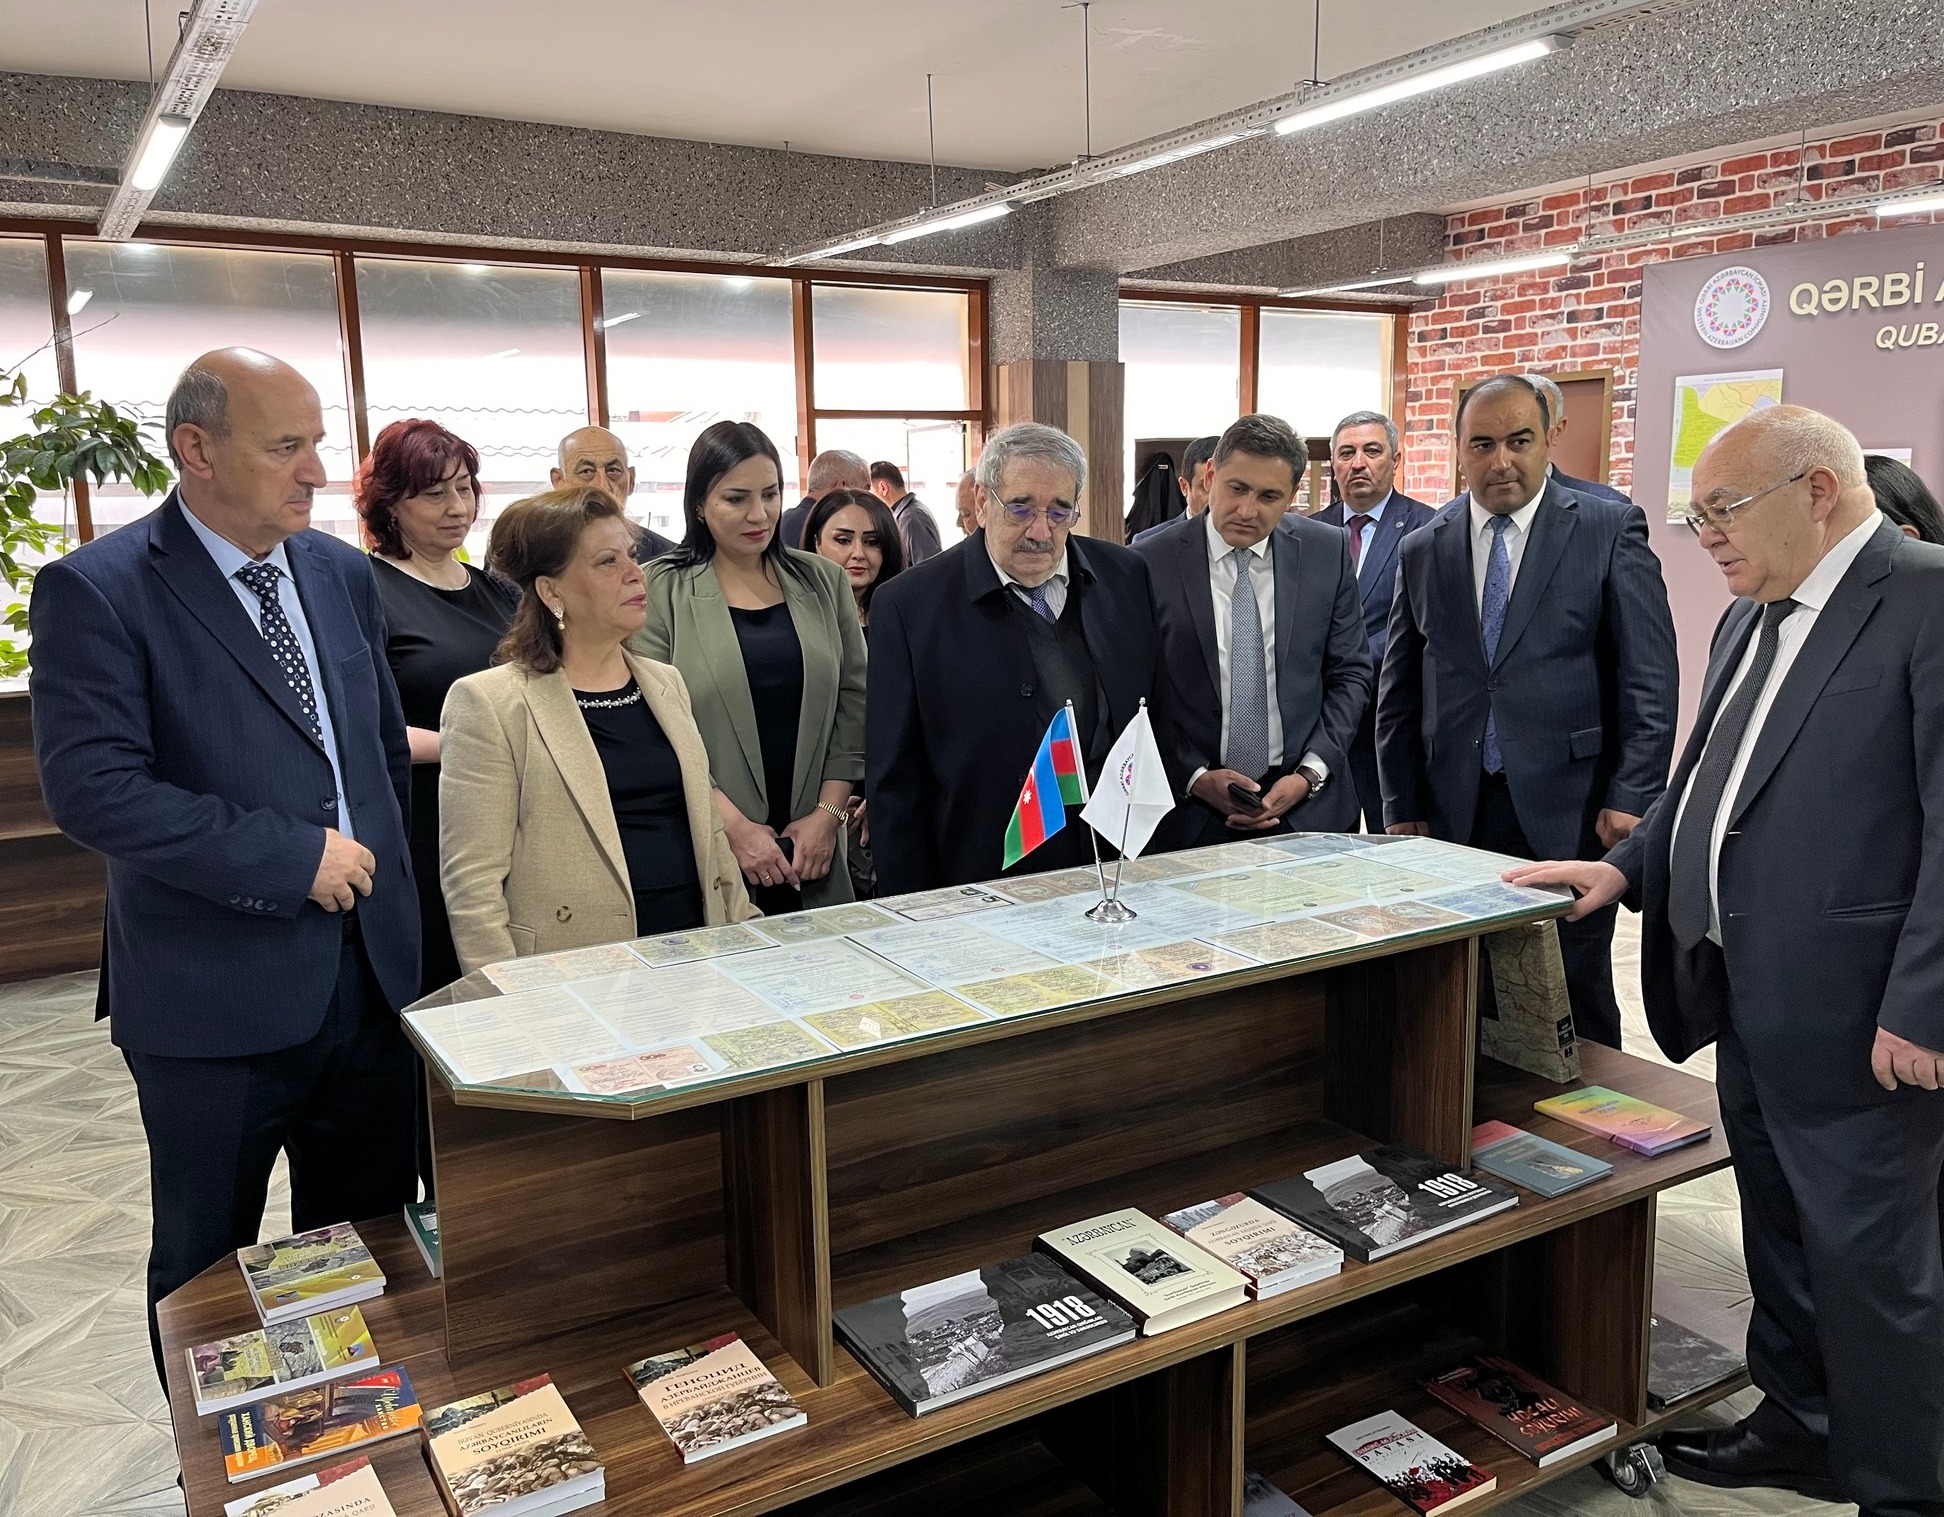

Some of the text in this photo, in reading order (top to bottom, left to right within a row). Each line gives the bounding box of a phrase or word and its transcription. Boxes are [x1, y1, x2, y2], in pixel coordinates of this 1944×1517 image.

[1789, 261, 1925, 316] QƏRBİ
[1417, 1172, 1479, 1199] 1918
[1224, 1226, 1276, 1246] SOYQIRIMI
[1026, 1295, 1097, 1330] 1918
[660, 1366, 762, 1403] АЗЕРБАЙДЖАНЦЕВ
[665, 1362, 747, 1392] ГЕНОЦИД
[472, 1427, 547, 1456] SOYQIRIMI
[1361, 1433, 1425, 1463] DAVASI
